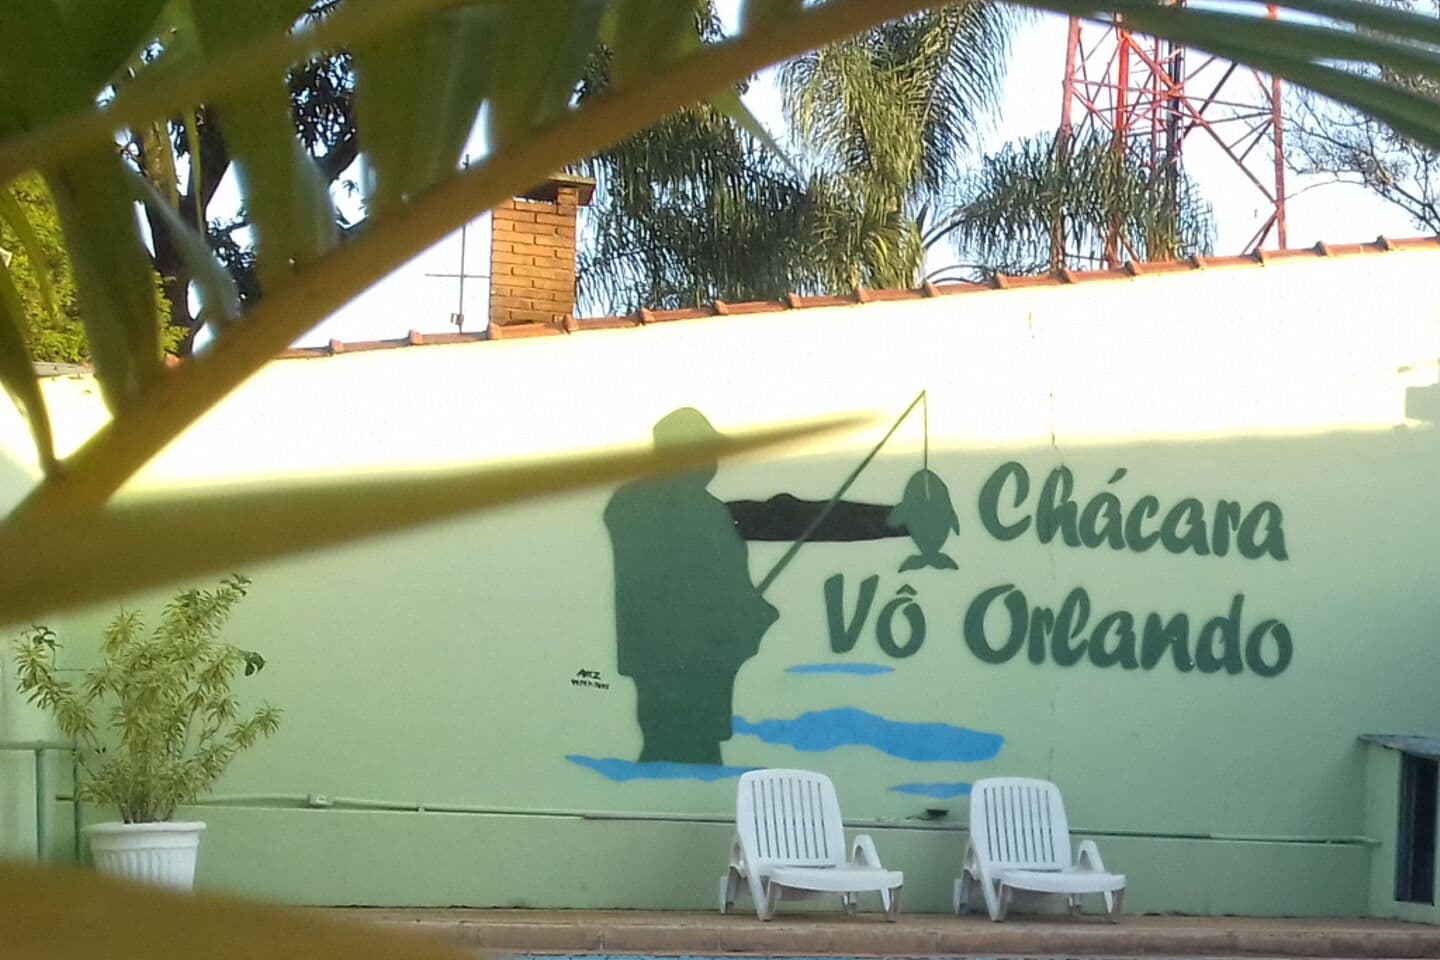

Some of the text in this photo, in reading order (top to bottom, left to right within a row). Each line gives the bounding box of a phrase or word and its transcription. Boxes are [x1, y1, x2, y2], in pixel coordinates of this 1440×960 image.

[978, 461, 1289, 561] Chácara
[823, 573, 1294, 677] Vô Orlando
